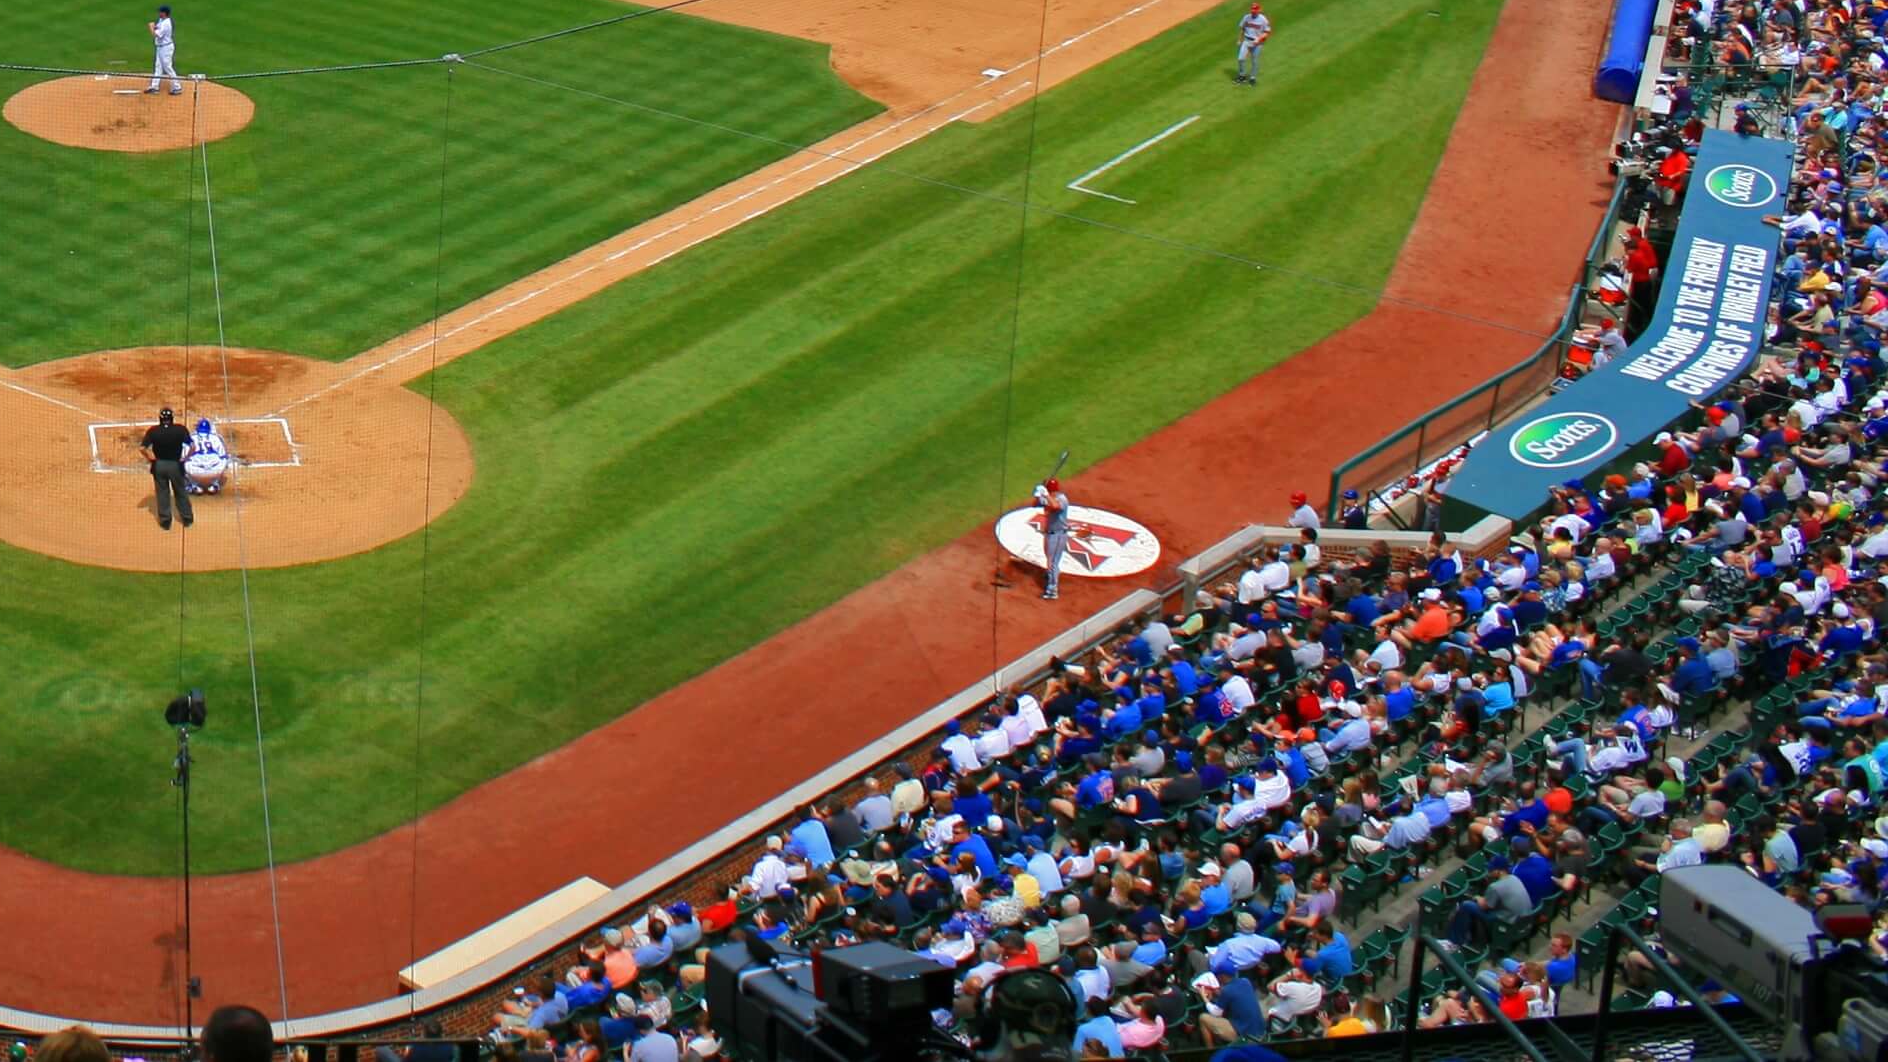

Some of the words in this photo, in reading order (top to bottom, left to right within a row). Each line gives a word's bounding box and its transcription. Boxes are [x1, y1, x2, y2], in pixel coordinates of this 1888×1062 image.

[1721, 169, 1757, 202] Scotts
[1683, 237, 1726, 288] FRIENDLY
[1730, 244, 1768, 275] FIELD
[1676, 285, 1716, 309] THE
[1719, 272, 1763, 323] WRIGLEY
[1673, 308, 1710, 326] TO
[1715, 322, 1752, 342] OF
[1620, 325, 1705, 380] WELCOME
[1665, 340, 1748, 395] CONFINES
[1525, 419, 1602, 459] Scotts
